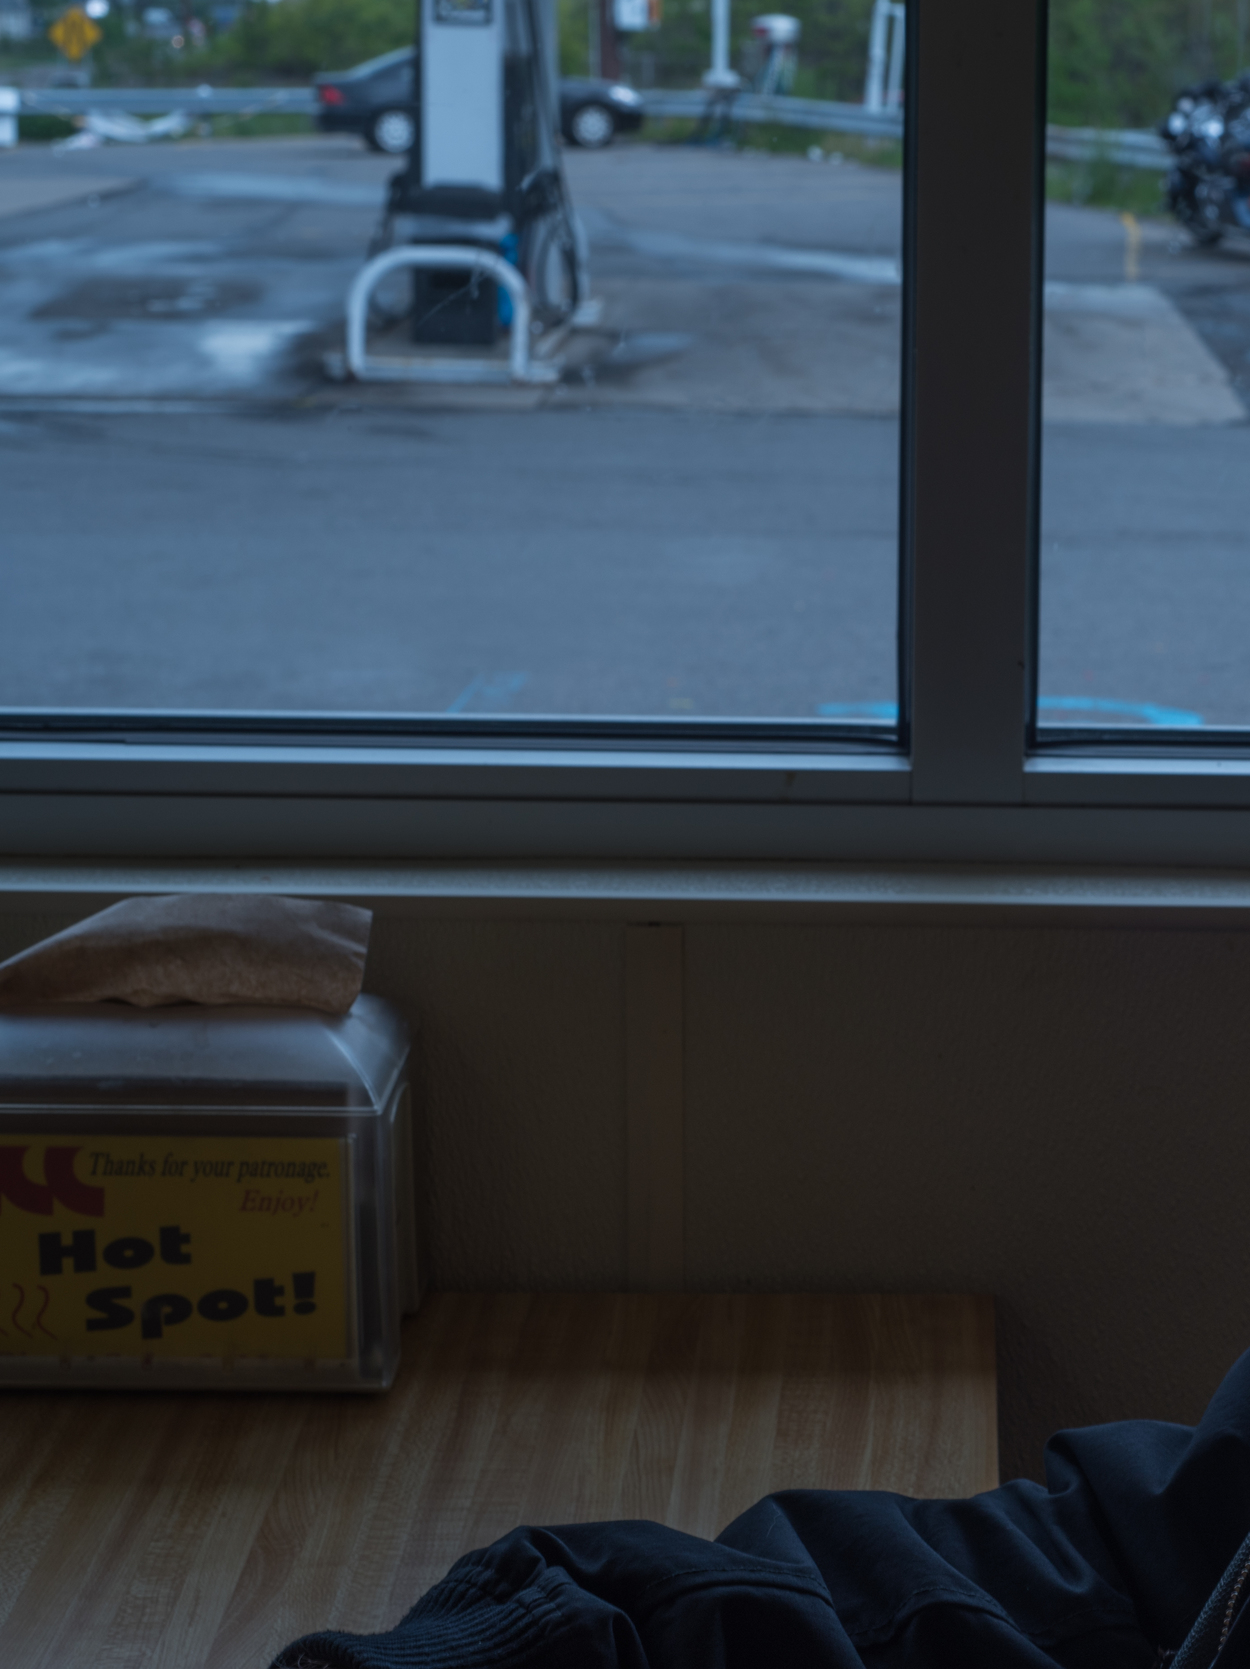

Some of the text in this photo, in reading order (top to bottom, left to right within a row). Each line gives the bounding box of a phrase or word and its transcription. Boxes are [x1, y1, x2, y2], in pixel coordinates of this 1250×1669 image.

[89, 1152, 330, 1184] Thanks for your patronage.
[239, 1189, 319, 1217] Enjoy!
[38, 1225, 192, 1276] Hot
[85, 1271, 317, 1339] Spot!
